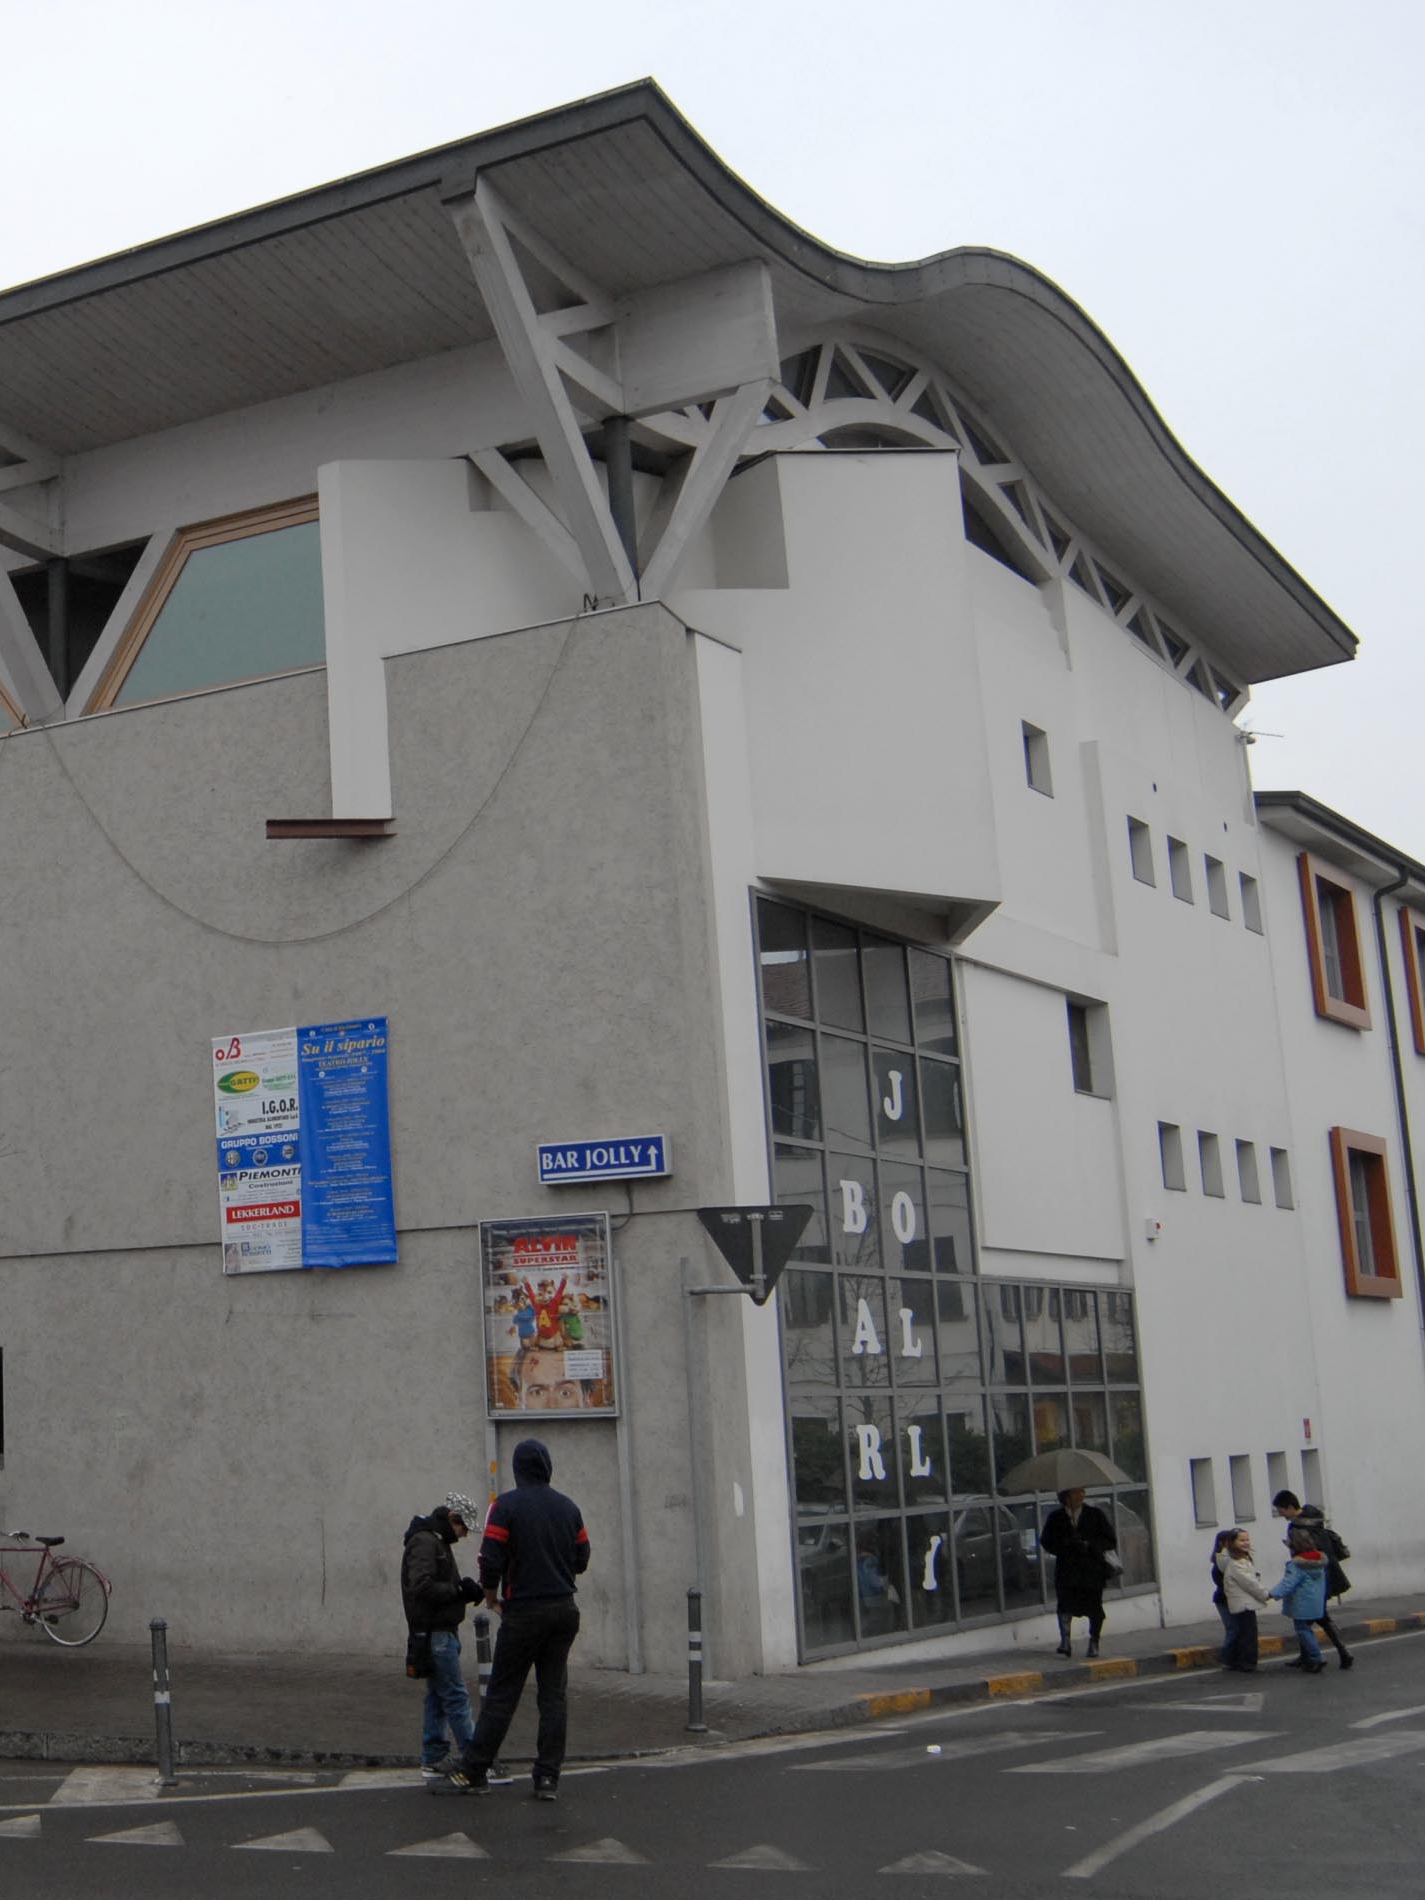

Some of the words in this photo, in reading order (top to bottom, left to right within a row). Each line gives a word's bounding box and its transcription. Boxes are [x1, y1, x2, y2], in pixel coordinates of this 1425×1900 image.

[302, 1043, 320, 1056] Su
[324, 1039, 335, 1053] il
[337, 1035, 385, 1052] sipario
[230, 1077, 256, 1086] GATTI
[262, 1098, 298, 1114] I.G.O.R.
[221, 1138, 257, 1149] GRUPPO
[259, 1133, 298, 1145] BOSSONI
[542, 1151, 579, 1170] BAR
[585, 1145, 642, 1170] JOLLY
[248, 1180, 293, 1189] Costruzioni
[232, 1205, 295, 1219] LEKKERLAND
[513, 1235, 577, 1253] ALVIN
[513, 1255, 577, 1265] SUPERSTAR
[539, 1309, 552, 1328] A
